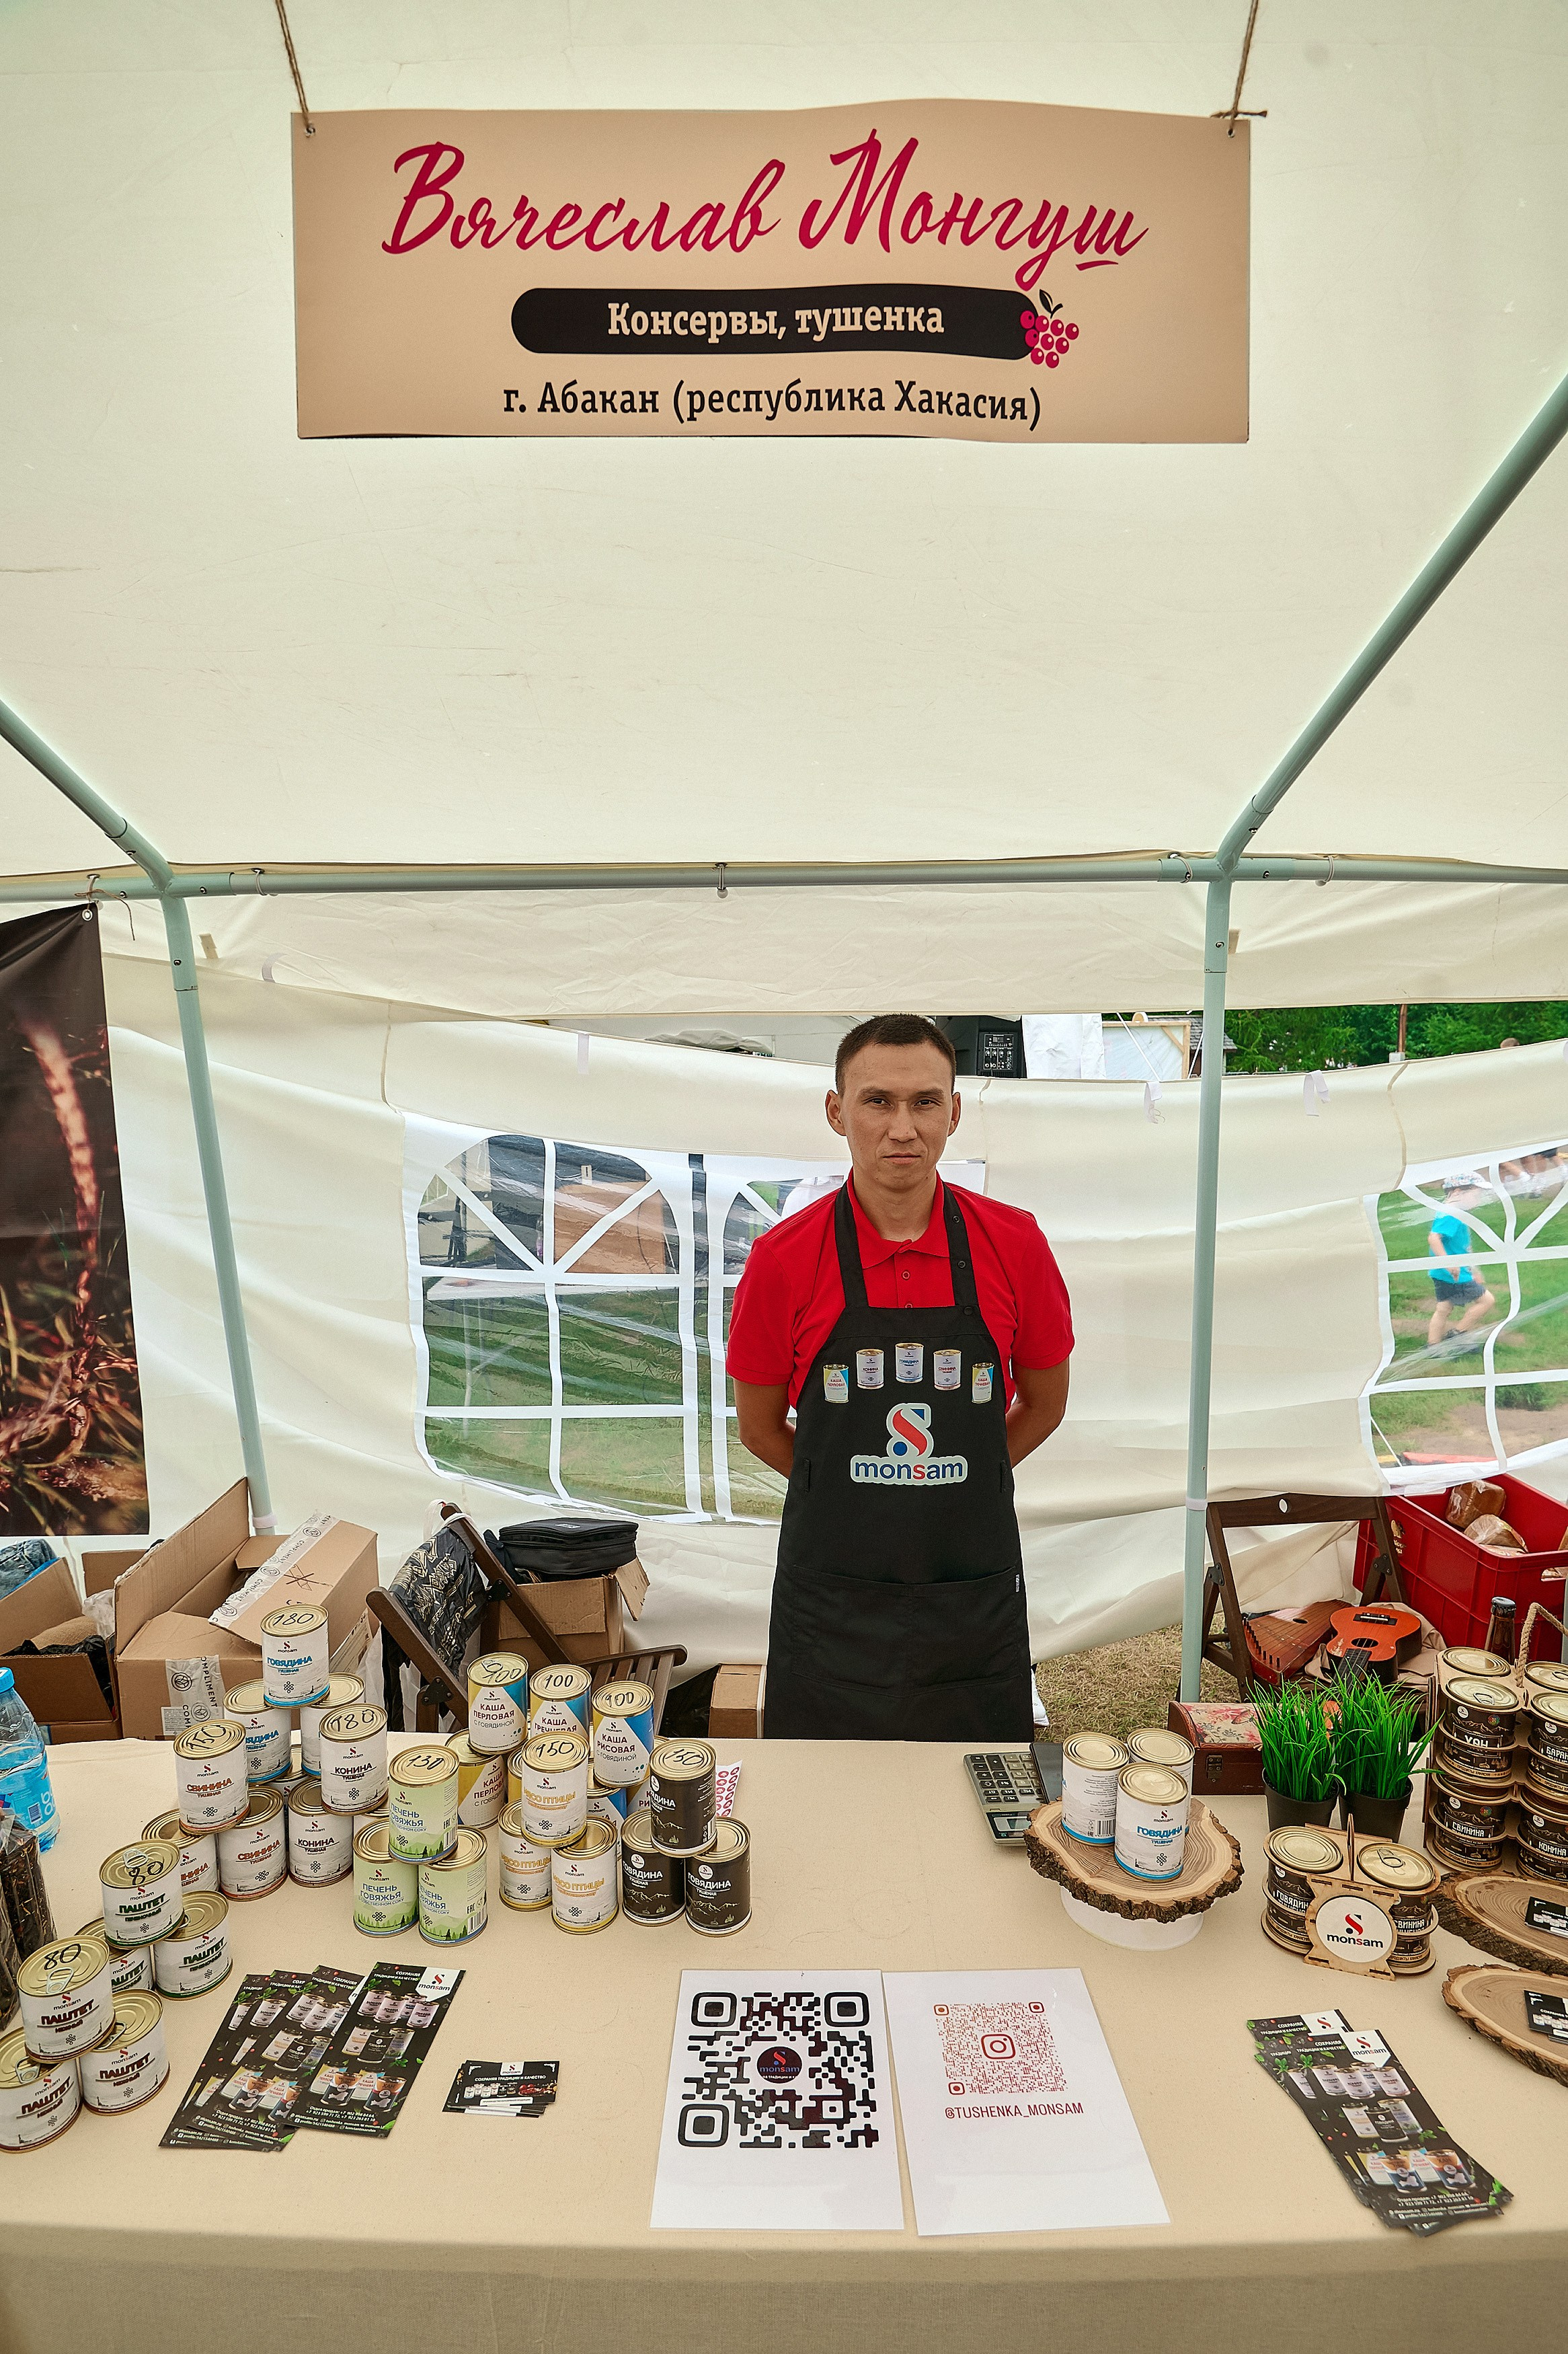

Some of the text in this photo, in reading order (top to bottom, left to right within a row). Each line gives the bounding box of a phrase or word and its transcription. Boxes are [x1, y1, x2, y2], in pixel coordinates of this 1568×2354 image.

[382, 128, 1149, 291] Вячеслав Монгуш
[608, 302, 944, 340] Консервы, тушенка
[503, 377, 1041, 430] г. Абакан (республика Хакасия)
[855, 1461, 963, 1480] monsam
[273, 1613, 314, 1626] 180
[267, 1656, 313, 1667] ГОВЯДИНА
[200, 1657, 217, 1708] OMPLIMENT
[545, 1675, 574, 1689] 100
[473, 1710, 514, 1720] ПЕРЛОВАЯ
[541, 1717, 567, 1726] КАША
[479, 1718, 514, 1729] ГОВЯДИНОЙ
[602, 1734, 627, 1743] КАША
[597, 1743, 635, 1753] РИСОВАЯ
[406, 1755, 444, 1770] 130
[600, 1753, 637, 1761] ГОВЯДИНОЙ
[335, 1762, 373, 1775] КОНИНА
[187, 1778, 232, 1792] СВИНИНА
[483, 1771, 502, 1787] КАША
[543, 1791, 576, 1804] ПТИЦЫ
[391, 1802, 420, 1819] ПЕЧЕНЬ
[1137, 1825, 1183, 1838] ГОВЯДИНА
[1452, 1821, 1485, 1837] СВИНИНА
[250, 1835, 270, 1844] monsam
[298, 1837, 335, 1848] КОНИНА
[237, 1839, 280, 1861] СВИНИНА
[1538, 1842, 1567, 1856] КОНИНА
[180, 1857, 197, 1866] onsam
[623, 1861, 663, 1881] ГОВЯДИНА
[573, 1878, 604, 1891] ПТИЦЫ
[687, 1872, 732, 1889] ГОВЯДИНА
[362, 1883, 397, 1893] ПЕЧЕНЬ
[119, 1893, 165, 1913] ПАШТЕТ
[130, 1891, 154, 1901] monsam
[360, 1891, 401, 1901] ГОВЯЖЬЯ
[1276, 1890, 1308, 1907] ГОВЯДИН
[195, 1937, 217, 1950] monsam
[1327, 1933, 1384, 1948] monsam
[44, 1943, 81, 1971] 80
[183, 1936, 225, 1965] ПАШТЕТ
[111, 1960, 145, 1986] АШТЕТ
[112, 1961, 135, 1974] monsam
[53, 1998, 81, 2010] monsam
[41, 1999, 94, 2025] ПАШТЕТ
[1352, 2047, 1387, 2055] monsam
[111, 2052, 138, 2065] monsam
[99, 2053, 150, 2079] ПАШТЕТ
[35, 2078, 61, 2096] monsam
[21, 2076, 71, 2114] ПАШТЕТ
[945, 2102, 1084, 2120] @TUSHENKA_MONSAM
